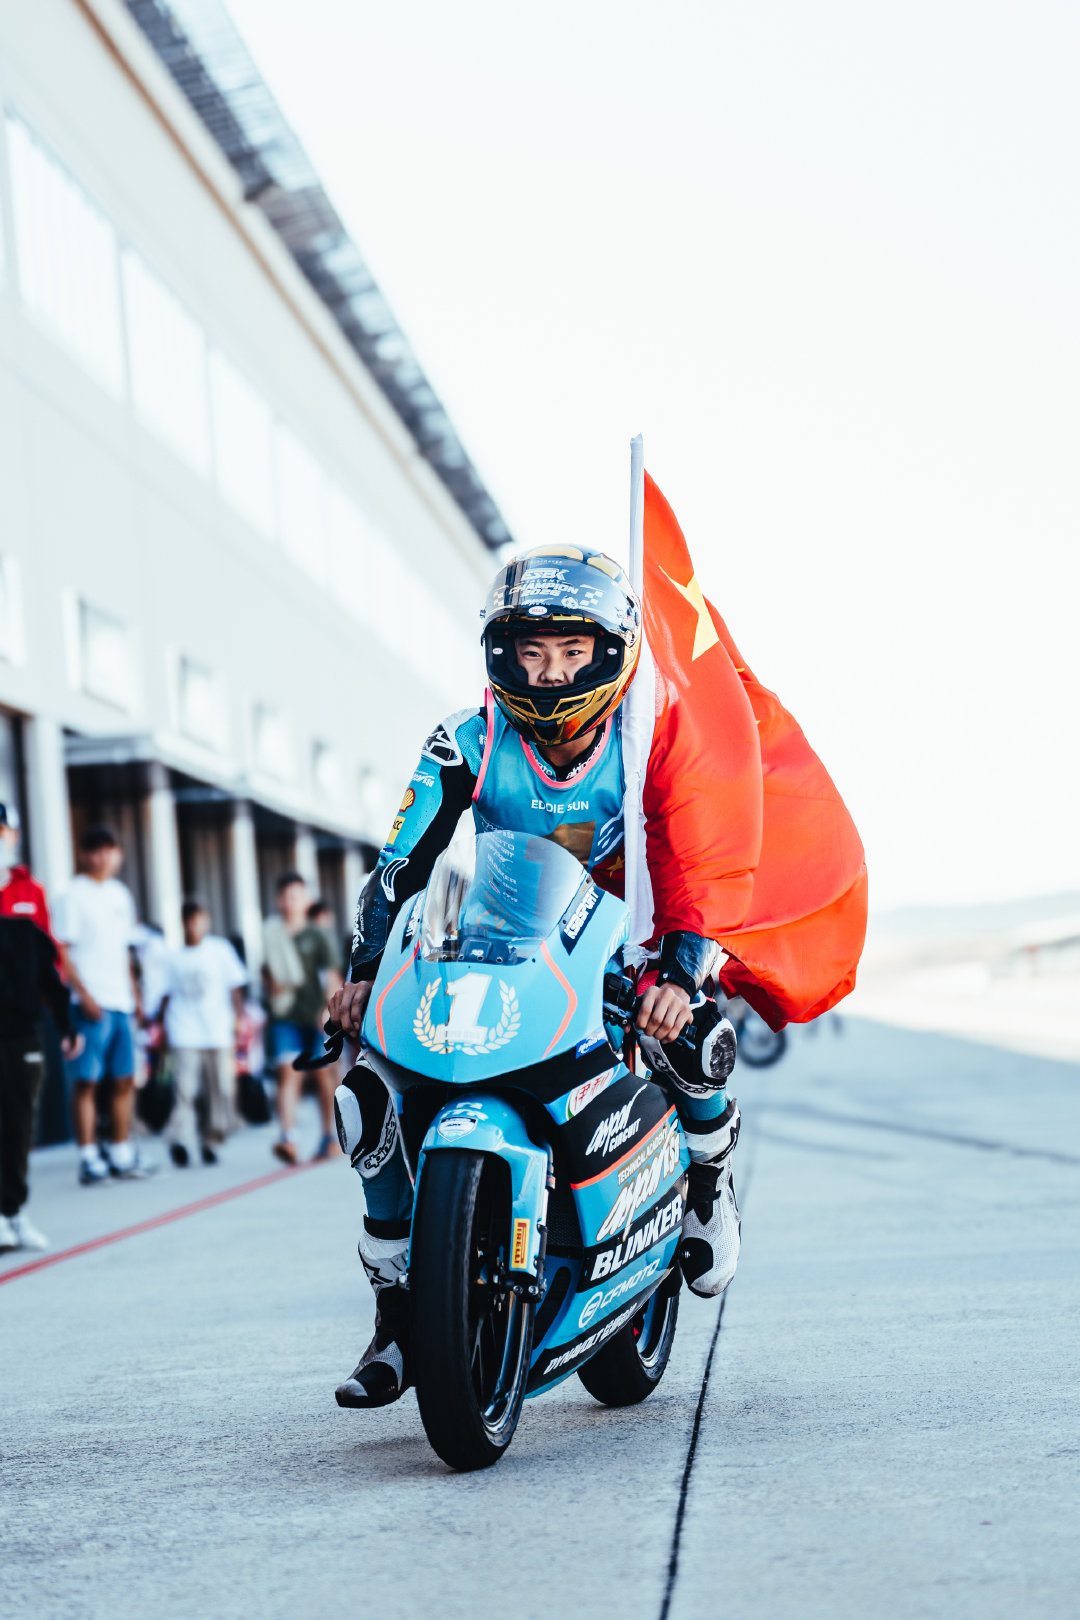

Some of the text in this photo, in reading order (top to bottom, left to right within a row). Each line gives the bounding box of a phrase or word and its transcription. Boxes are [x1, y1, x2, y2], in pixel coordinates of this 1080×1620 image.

[509, 582, 579, 595] CHAMPION
[531, 799, 589, 814] EDDIE SUN
[432, 972, 493, 1045] 1
[609, 1118, 641, 1152] CIRCUIT
[514, 1223, 527, 1264] PIRELLI
[590, 1193, 683, 1281] BLINKER
[600, 1257, 661, 1308] CFMOTO
[543, 1328, 604, 1375] DYNAVOLT
